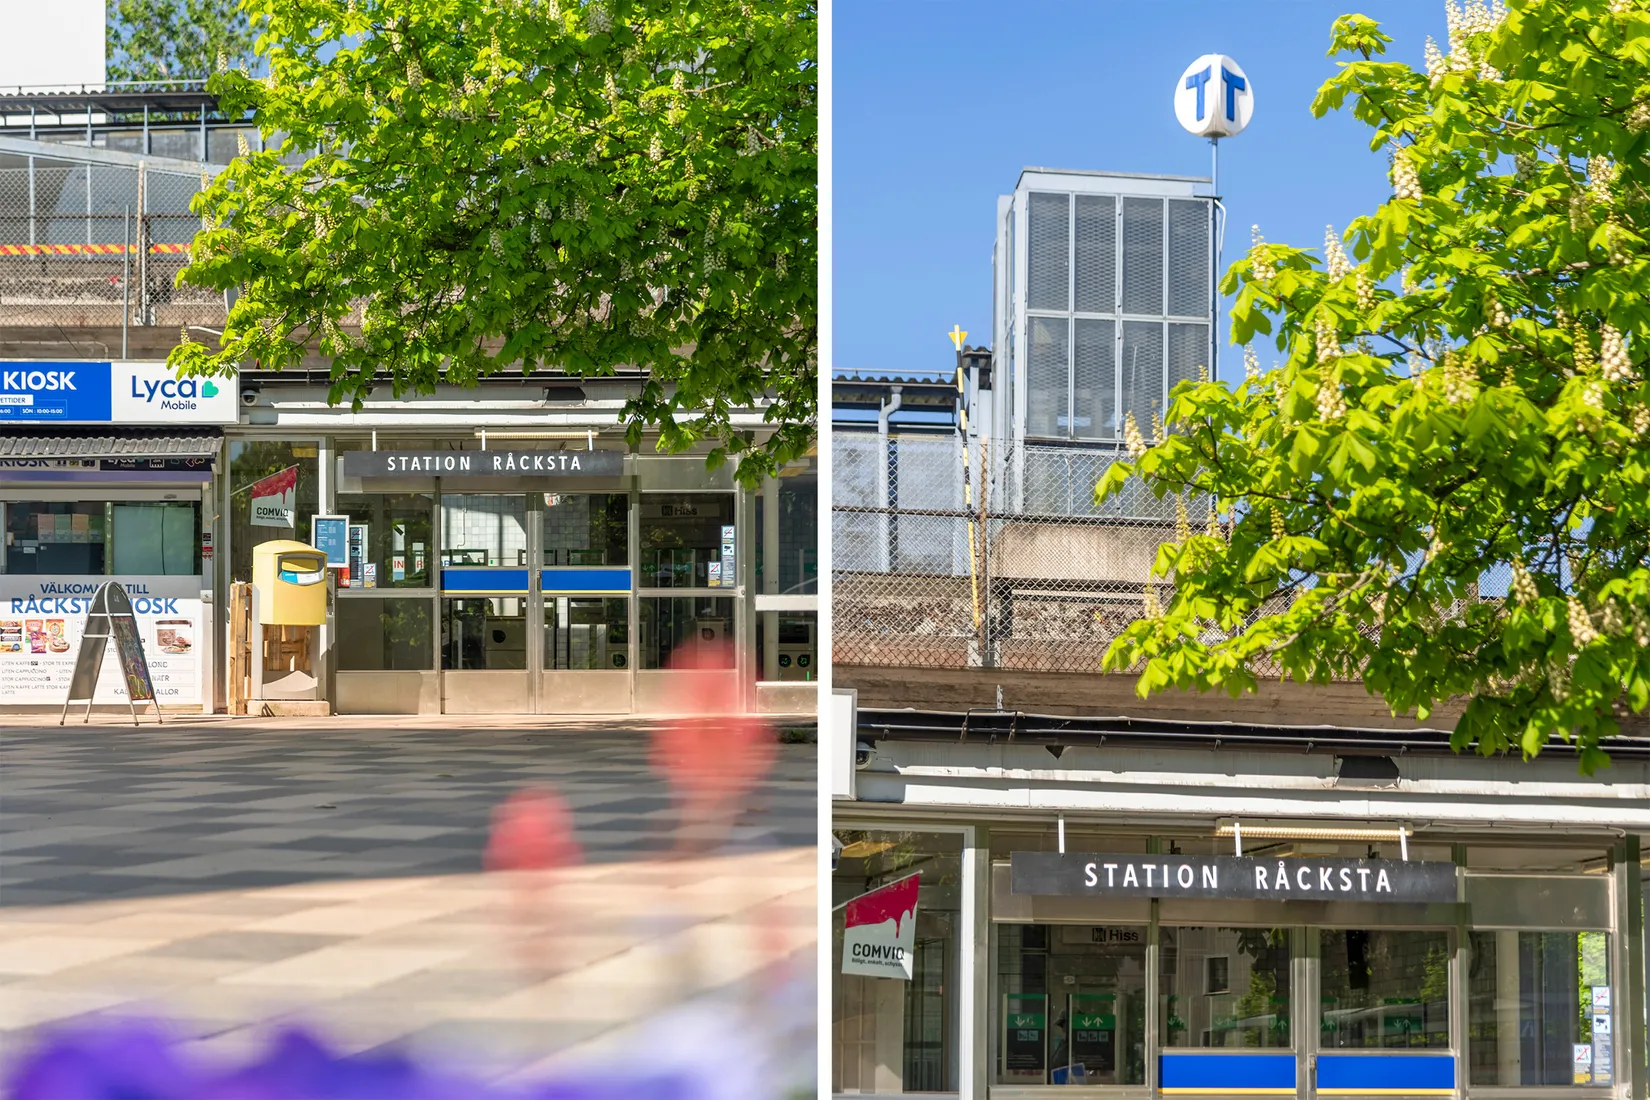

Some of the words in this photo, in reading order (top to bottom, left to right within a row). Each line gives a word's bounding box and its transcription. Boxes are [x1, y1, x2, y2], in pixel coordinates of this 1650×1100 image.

[1186, 64, 1211, 122] T
[1221, 64, 1245, 122] T
[4, 371, 77, 390] KIOSK
[131, 375, 197, 403] Lyca
[160, 400, 197, 410] Mobile
[387, 456, 471, 471] STATION
[493, 452, 581, 471] RÅCKSTA
[256, 506, 289, 517] COMVIQ
[40, 582, 101, 594] VÄLKOM
[125, 583, 150, 594] TILL
[11, 594, 92, 614] RÅCKST
[130, 597, 179, 615] OSK
[1085, 862, 1218, 889] STATION
[1255, 861, 1392, 893] RÅCKSTA
[1109, 929, 1140, 942] Hiss
[852, 942, 905, 961] COMVIQ
